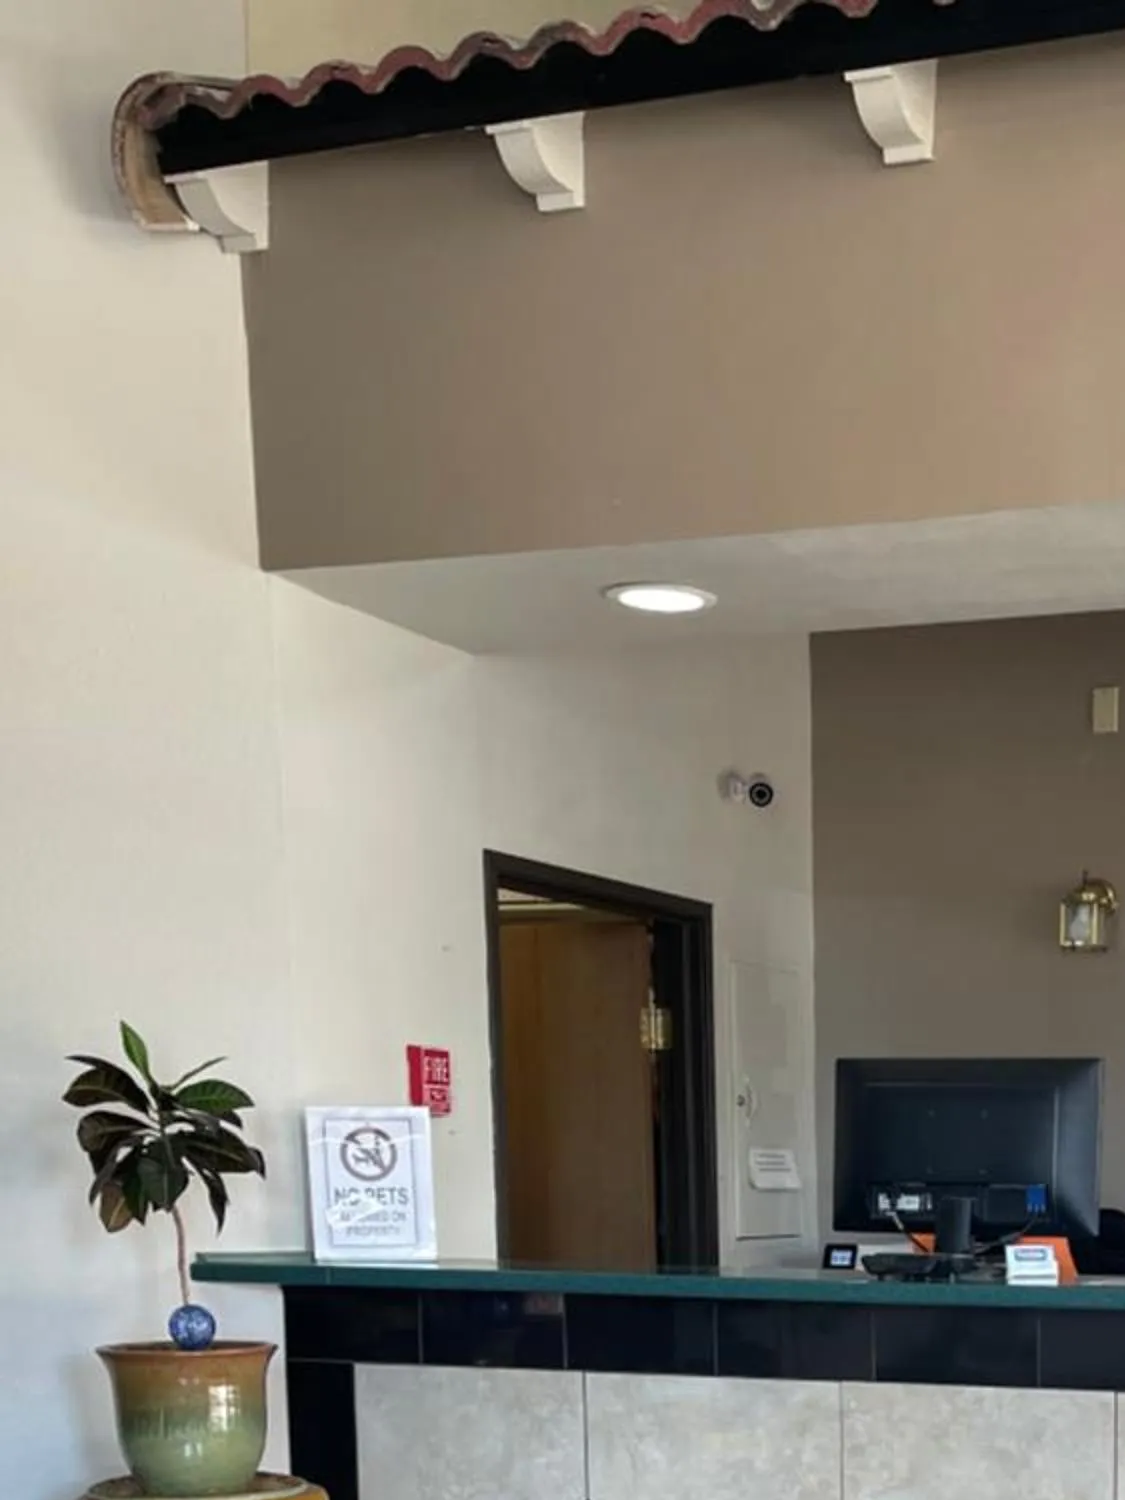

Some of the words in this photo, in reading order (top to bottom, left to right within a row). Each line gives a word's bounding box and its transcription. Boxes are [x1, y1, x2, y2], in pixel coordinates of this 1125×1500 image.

[423, 1056, 449, 1082] FIRE
[333, 1186, 361, 1206] NO
[364, 1186, 410, 1206] PETS
